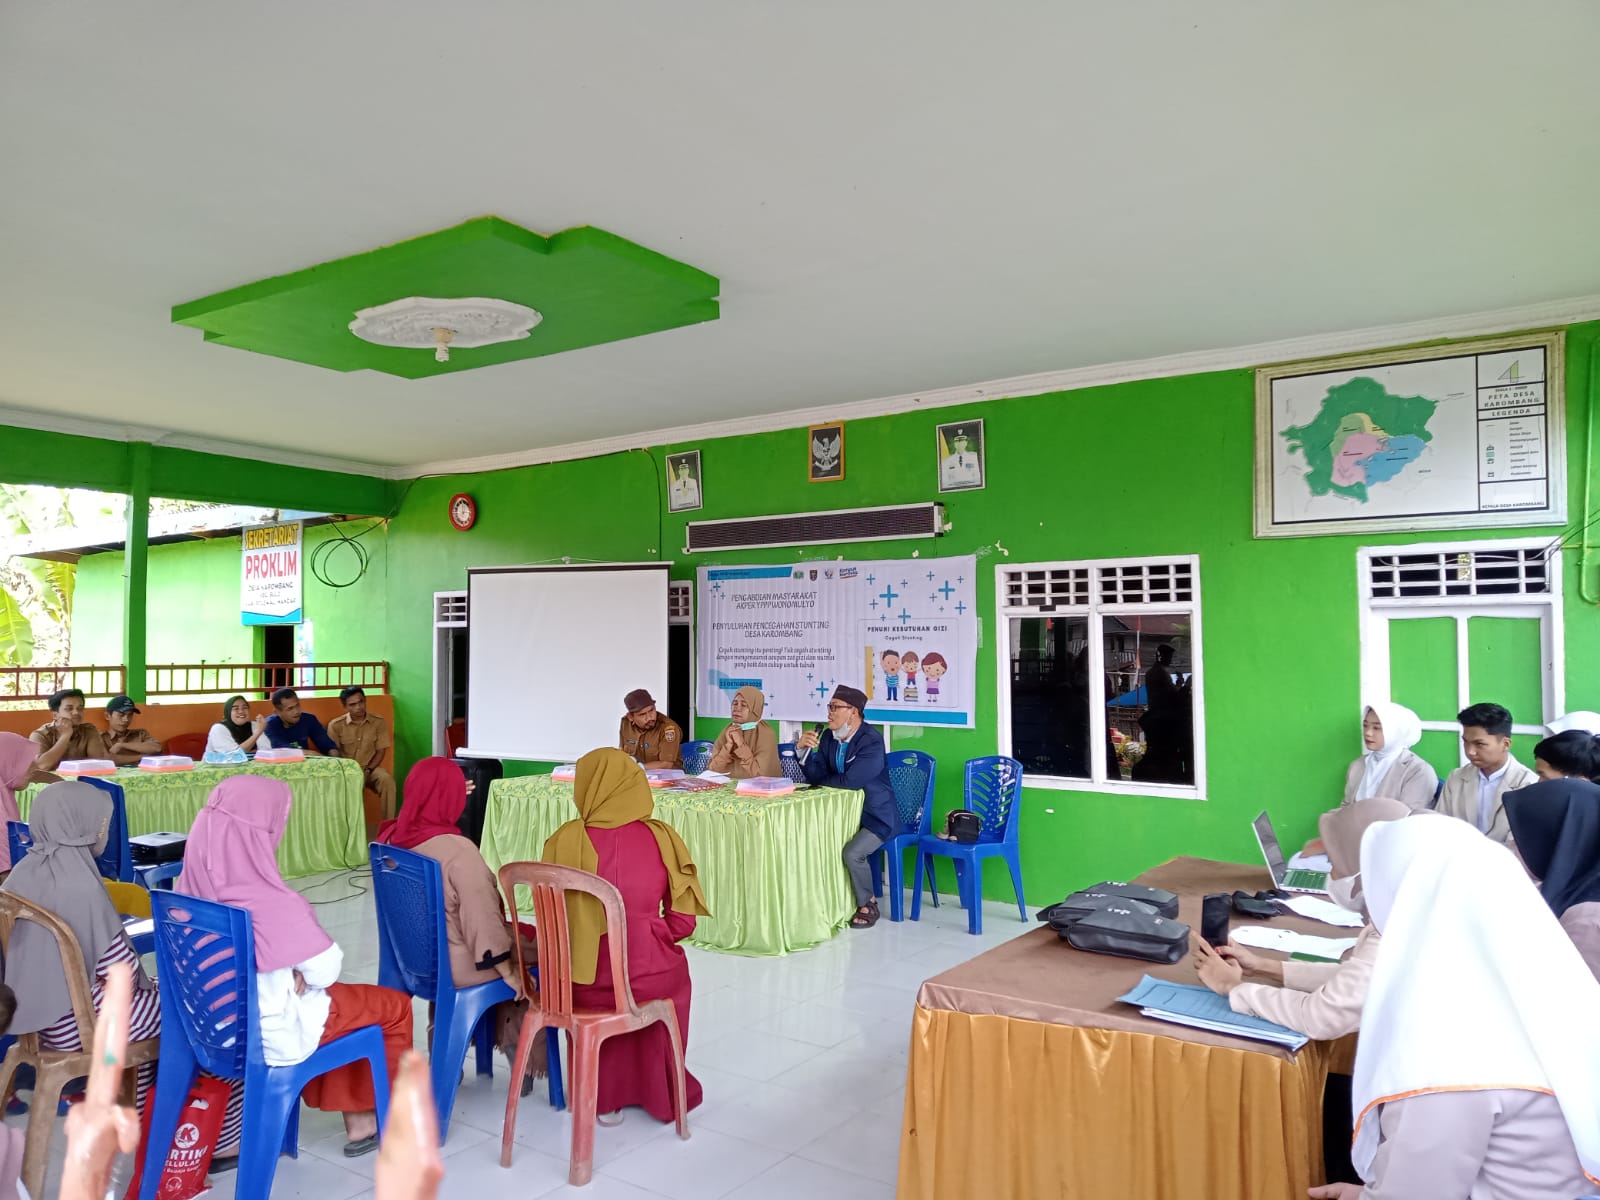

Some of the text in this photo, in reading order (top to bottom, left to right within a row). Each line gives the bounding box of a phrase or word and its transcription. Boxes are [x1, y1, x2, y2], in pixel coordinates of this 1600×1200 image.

[1491, 408, 1531, 416] LEGENDA
[245, 523, 299, 550] SEKRETARIAT
[245, 551, 297, 580] PROKLIM
[731, 591, 818, 602] PENGABDIAN MASYARAKAT
[712, 620, 830, 630] PENYULUHAN PENCEGAHAN STUNTING
[744, 629, 804, 638] DESA KAROMBANG
